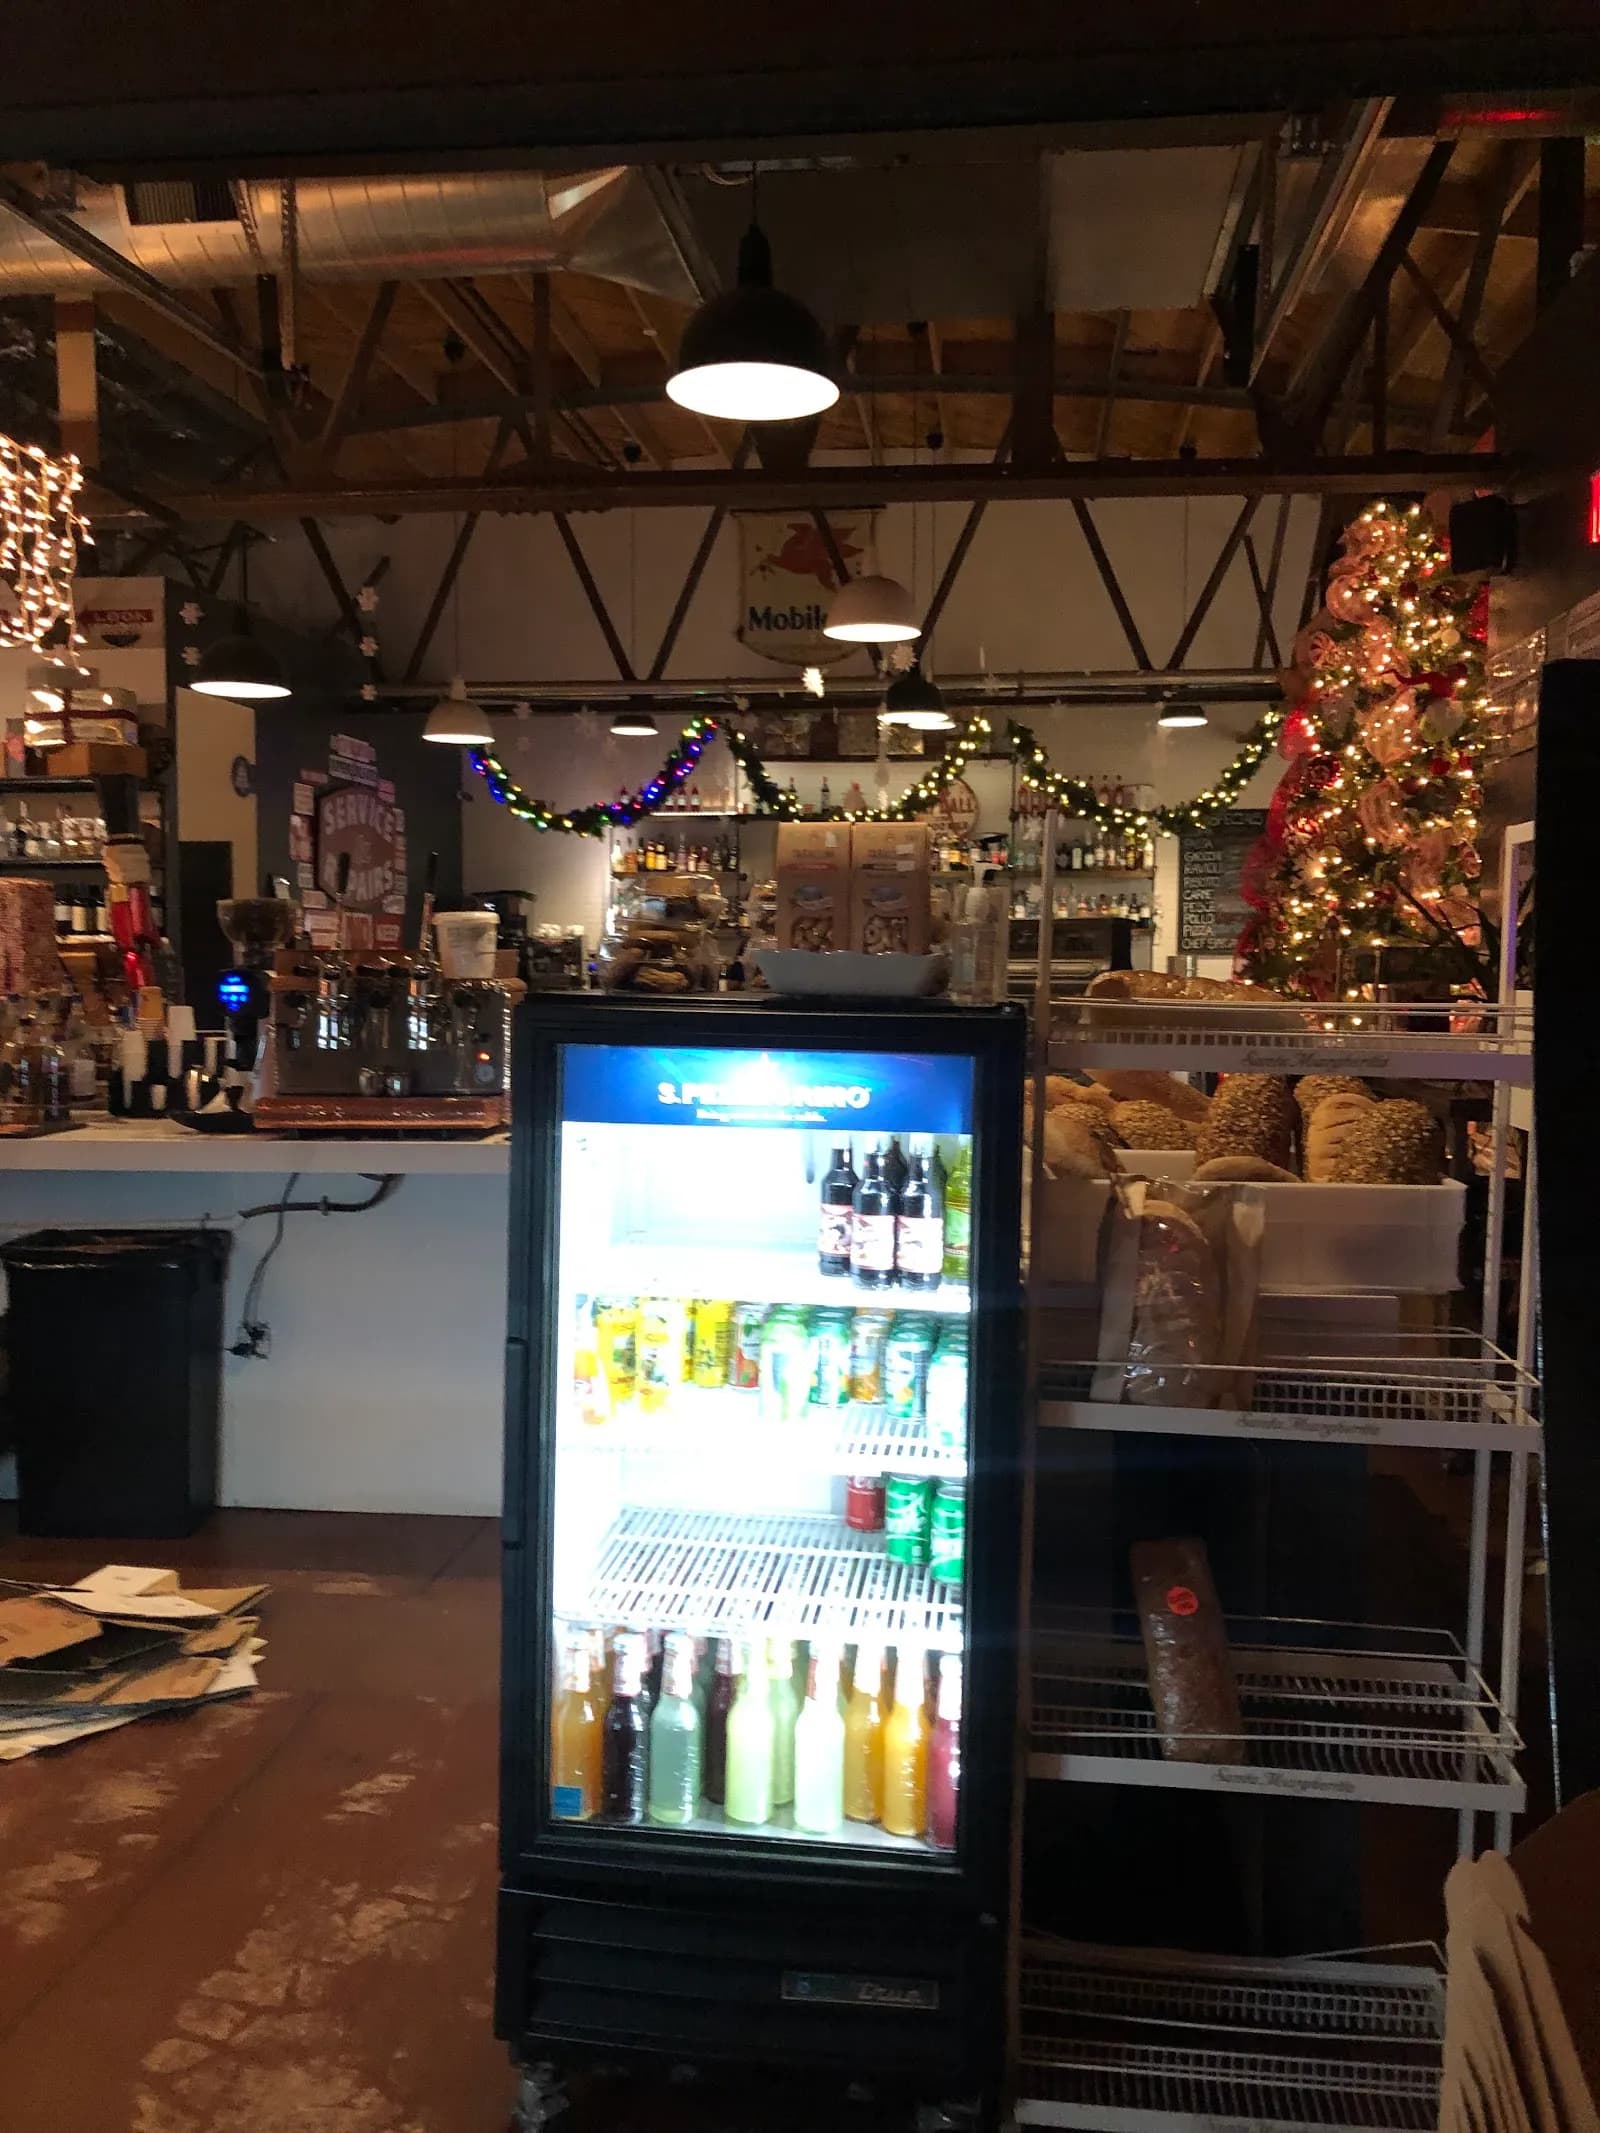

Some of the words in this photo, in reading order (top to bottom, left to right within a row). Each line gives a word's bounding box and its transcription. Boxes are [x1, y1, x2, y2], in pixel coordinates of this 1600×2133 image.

[750, 605, 828, 631] Mobil
[324, 794, 394, 842] SERVICE
[324, 852, 394, 903] RPAIRS
